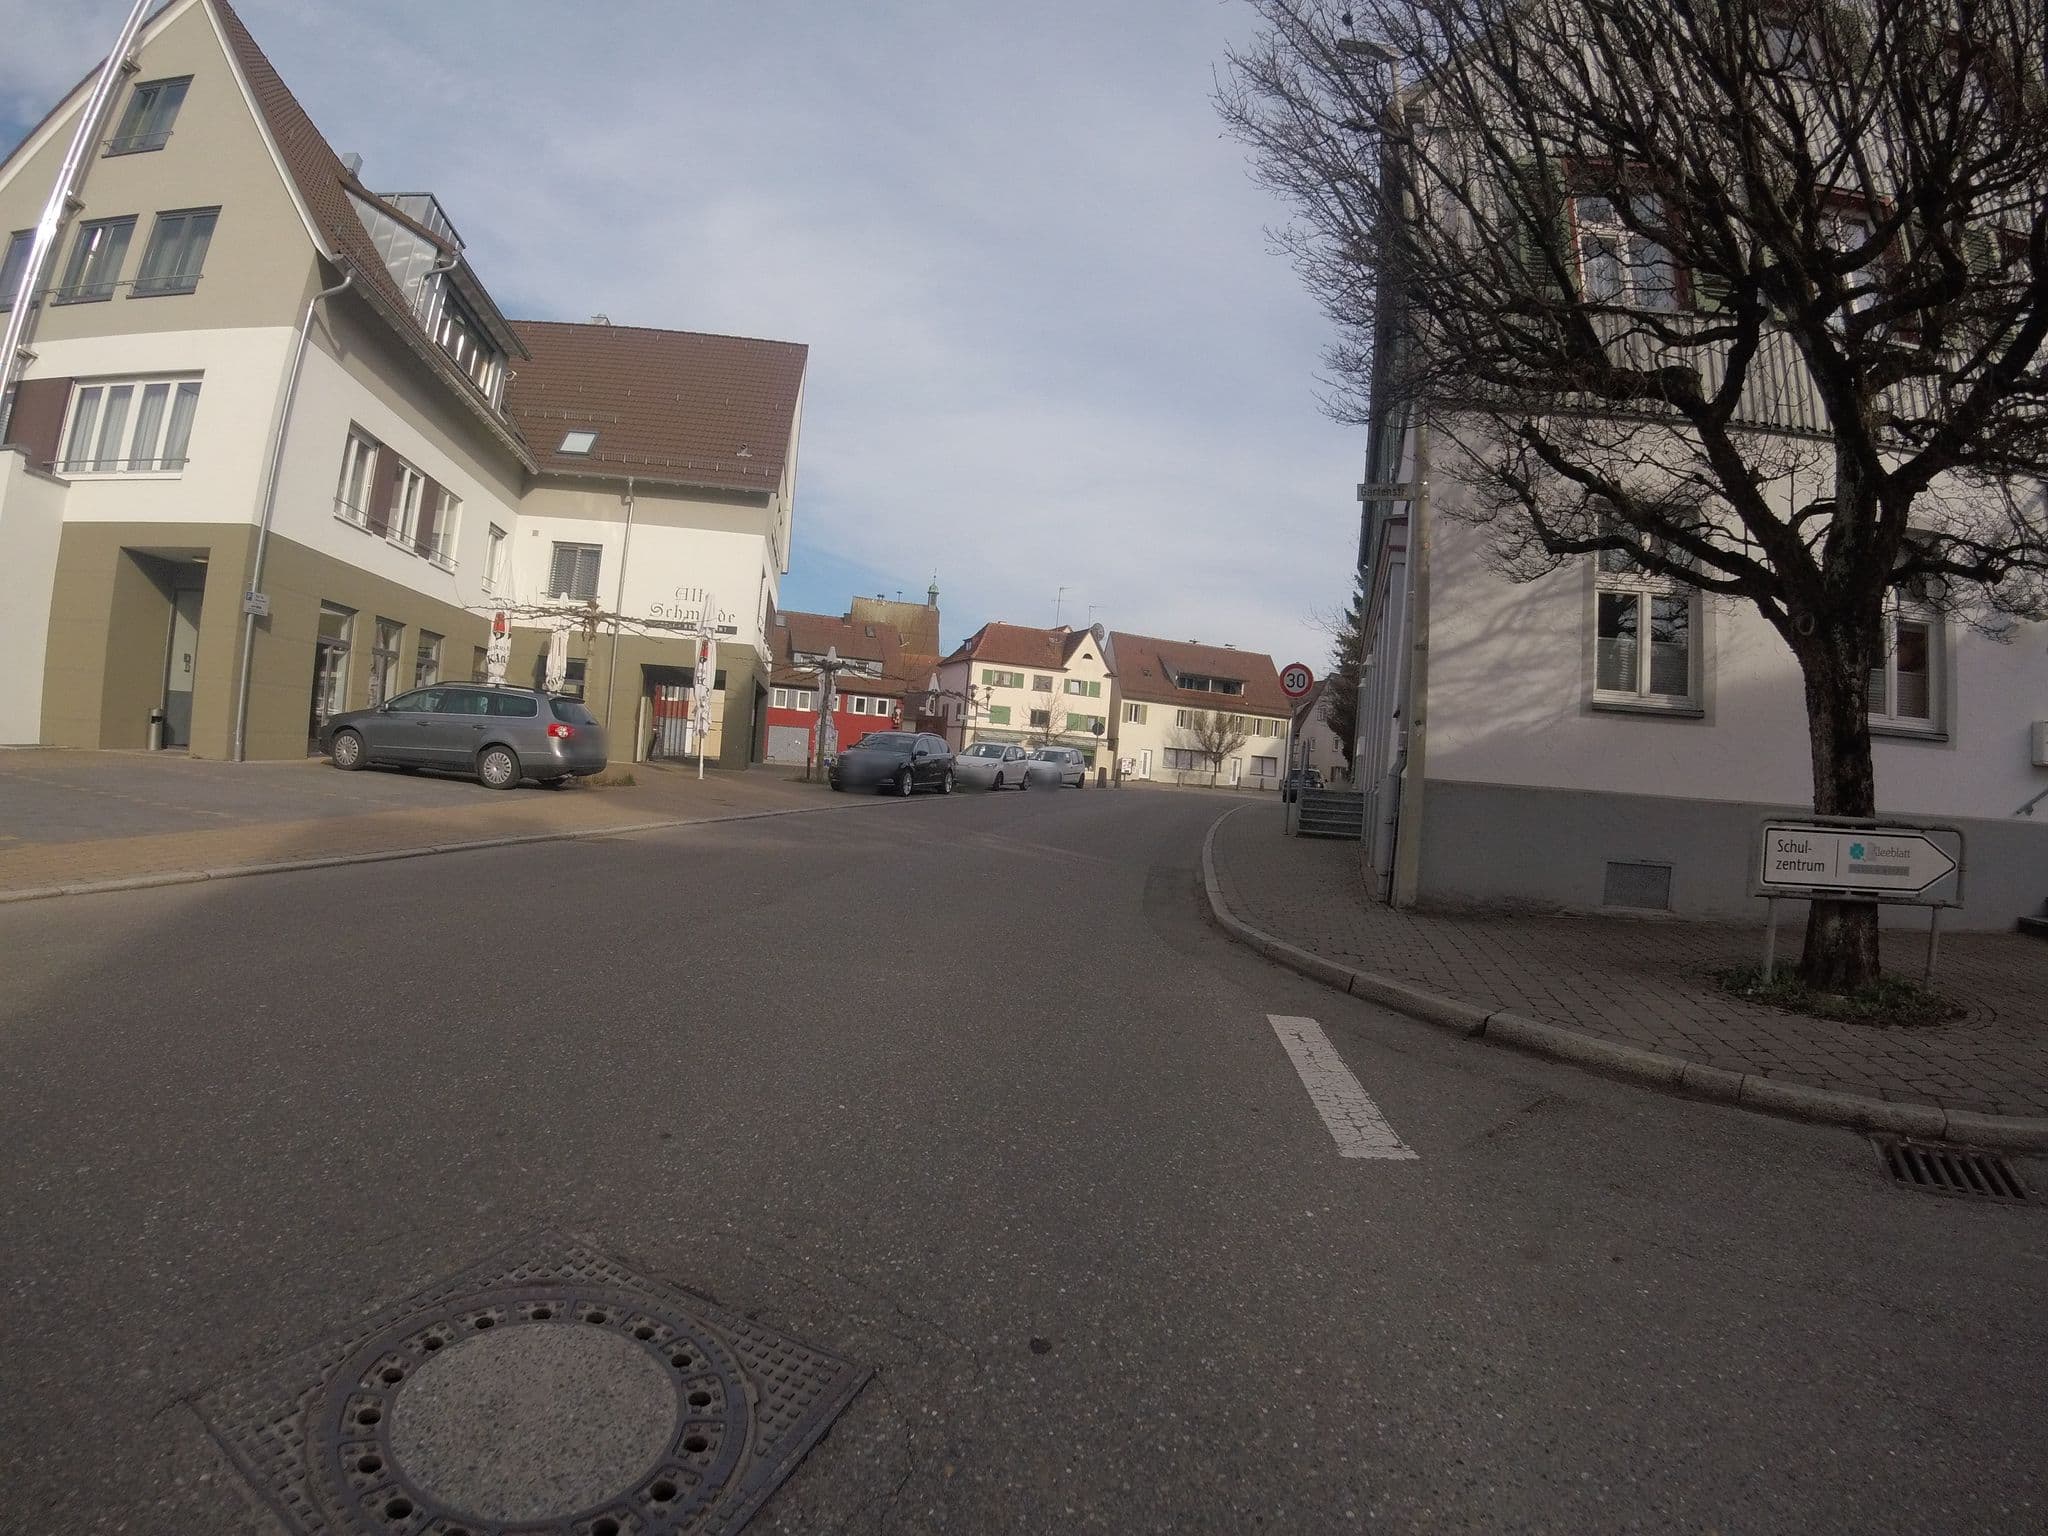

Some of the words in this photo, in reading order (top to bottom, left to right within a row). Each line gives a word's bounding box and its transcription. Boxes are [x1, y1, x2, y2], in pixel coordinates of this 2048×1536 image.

[674, 586, 709, 602] Alt
[650, 603, 736, 624] Schmde
[1286, 673, 1306, 688] 30
[1777, 839, 1812, 853] Schul-
[1776, 859, 1825, 872] zentrum
